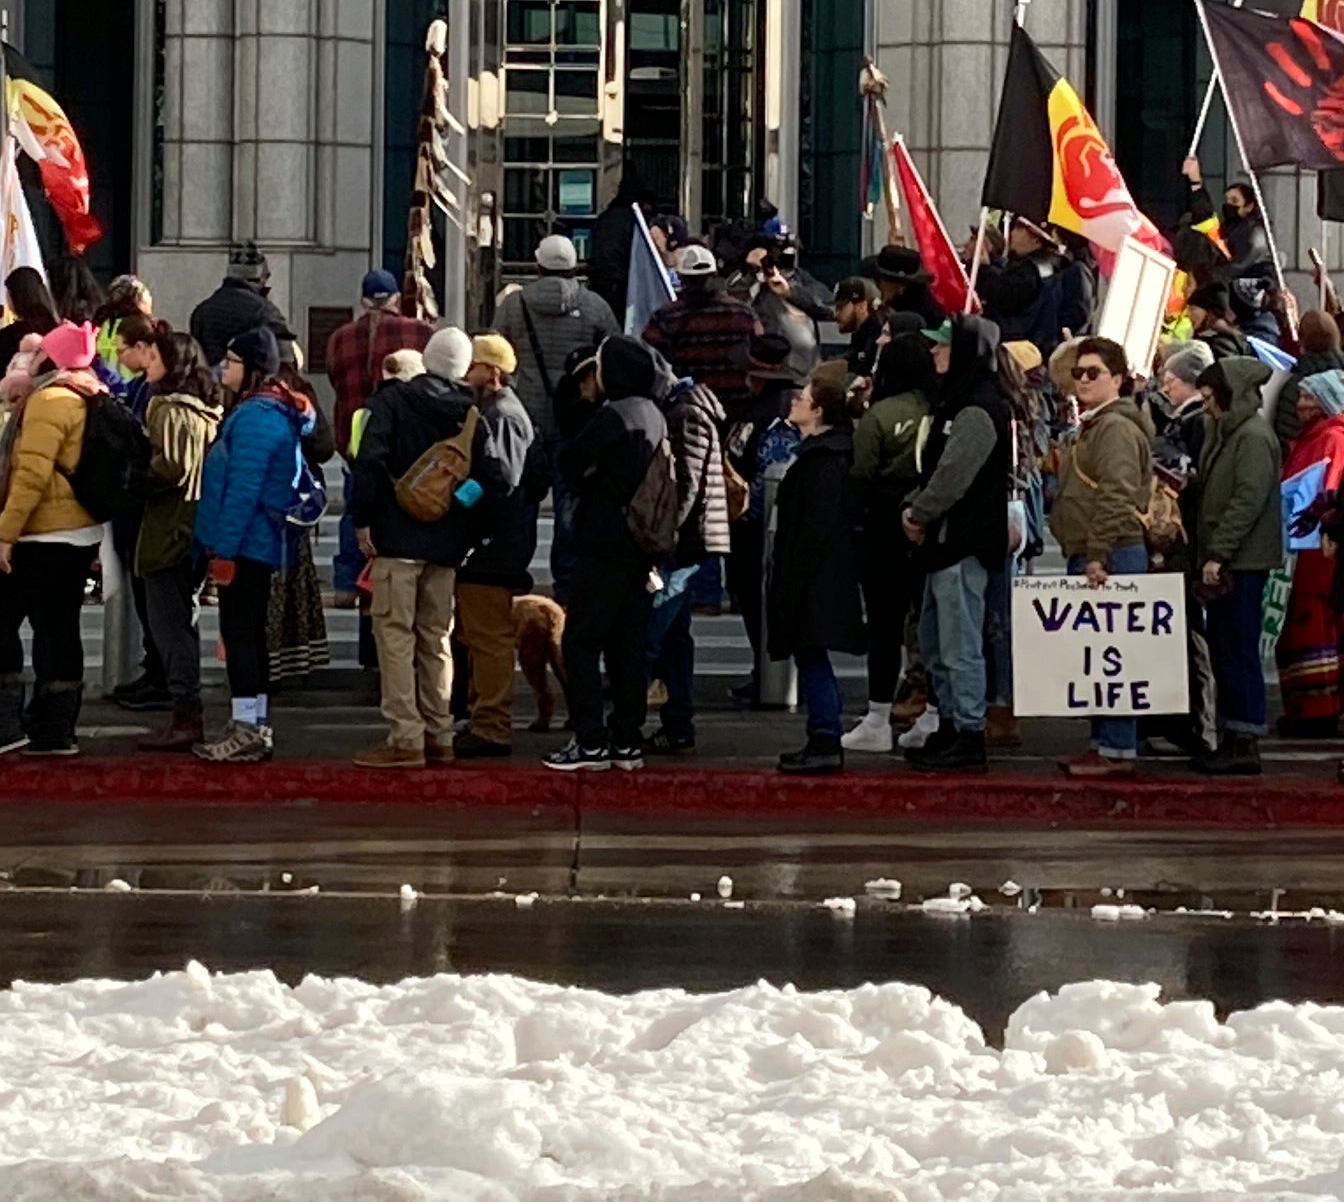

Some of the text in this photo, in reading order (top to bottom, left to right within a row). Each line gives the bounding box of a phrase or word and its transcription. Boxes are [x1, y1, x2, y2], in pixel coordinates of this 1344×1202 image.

[1032, 597, 1174, 635] WATER
[1084, 646, 1122, 676] IS
[1068, 680, 1151, 710] LIFE
